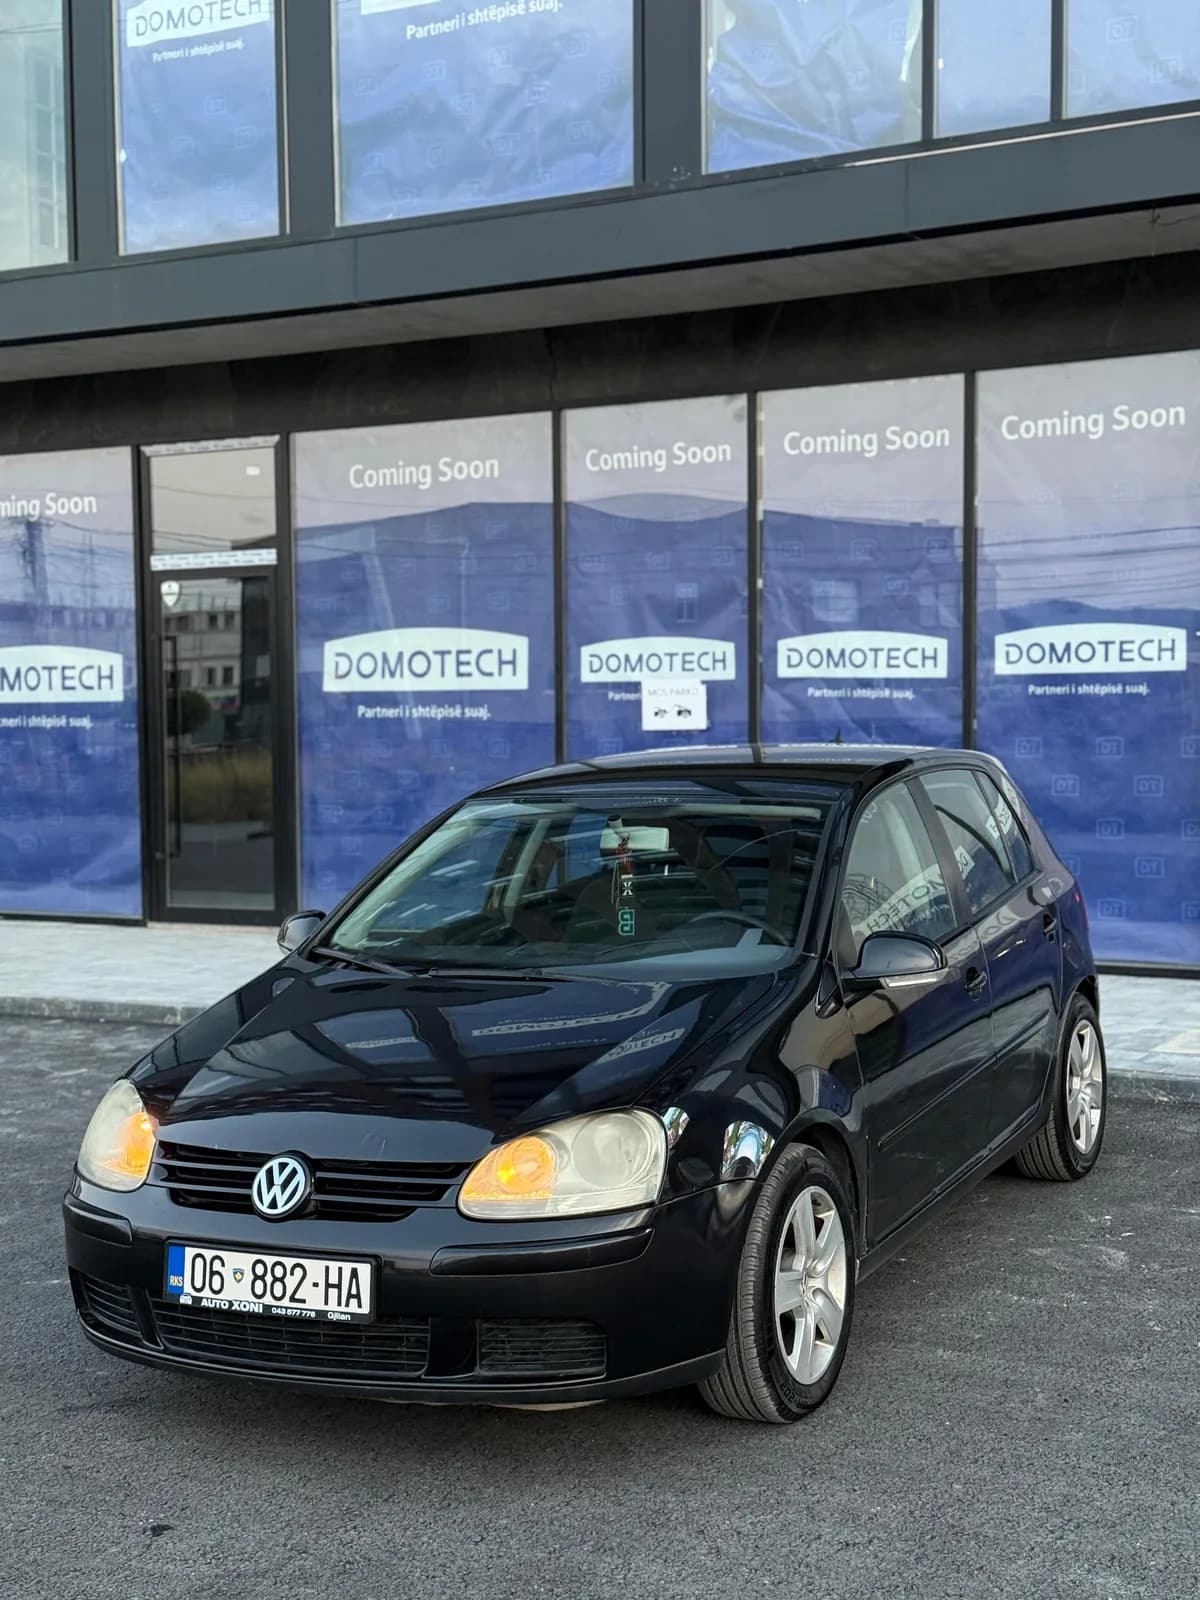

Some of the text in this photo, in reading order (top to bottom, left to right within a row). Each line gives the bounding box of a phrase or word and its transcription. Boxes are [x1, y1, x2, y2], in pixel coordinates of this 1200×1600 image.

[136, 0, 261, 36] DOMOTECH
[406, 15, 460, 40] Partneri
[461, 12, 466, 27] i
[467, 4, 526, 25] shtëpisë
[1001, 404, 1186, 440] Coming Soon
[783, 426, 950, 457] Coming Soon
[585, 441, 732, 472] Coming Soon
[350, 456, 499, 490] Coming Soon
[45, 491, 97, 515] Soon
[588, 651, 727, 673] DOMOTECH
[786, 648, 938, 669] DOMOTECH
[1005, 638, 1176, 664] DOMOTECH
[334, 648, 517, 680] DOMOTECH
[0, 664, 113, 691] MOTECH
[1028, 684, 1070, 695] Partneri
[1077, 683, 1123, 697] shtëpisë
[1125, 682, 1151, 696] suaj.
[807, 687, 846, 698] Partneri
[357, 705, 403, 719] Partneri
[412, 704, 461, 721] shtëpisë
[464, 704, 491, 720] suaj.
[1056, 779, 1075, 792] DT
[1139, 779, 1158, 792] DT
[1140, 861, 1158, 873] DT
[169, 1274, 184, 1287] RKS
[190, 1252, 363, 1309] 06 882-HA
[200, 1298, 229, 1310] AUTO
[231, 1300, 264, 1314] XONI
